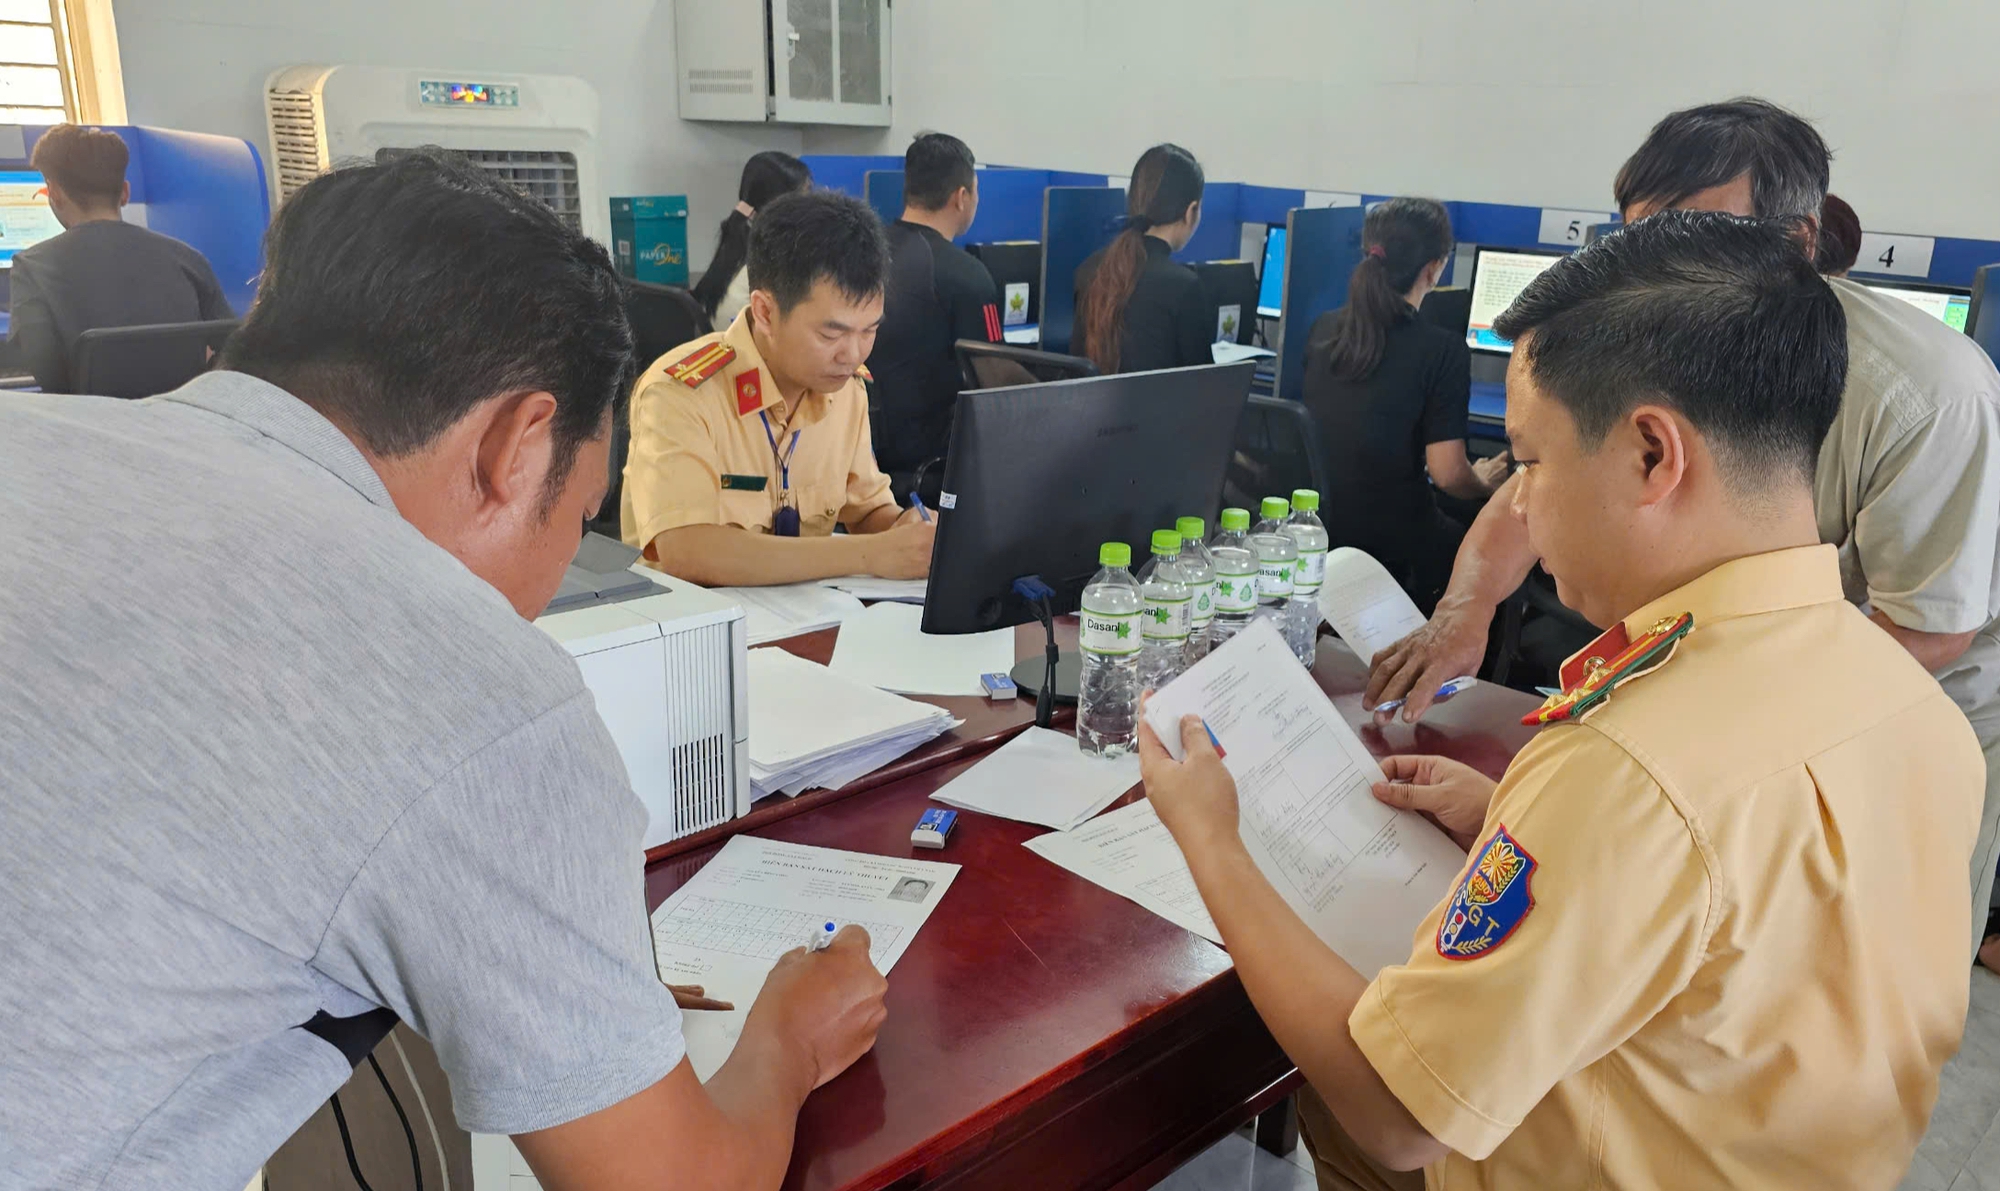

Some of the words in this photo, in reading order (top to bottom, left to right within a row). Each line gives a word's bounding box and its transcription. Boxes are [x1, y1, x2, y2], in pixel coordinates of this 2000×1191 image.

[1566, 220, 1581, 241] 5
[1878, 245, 1895, 268] 4
[1259, 567, 1283, 578] asani
[1087, 618, 1120, 632] Dasani
